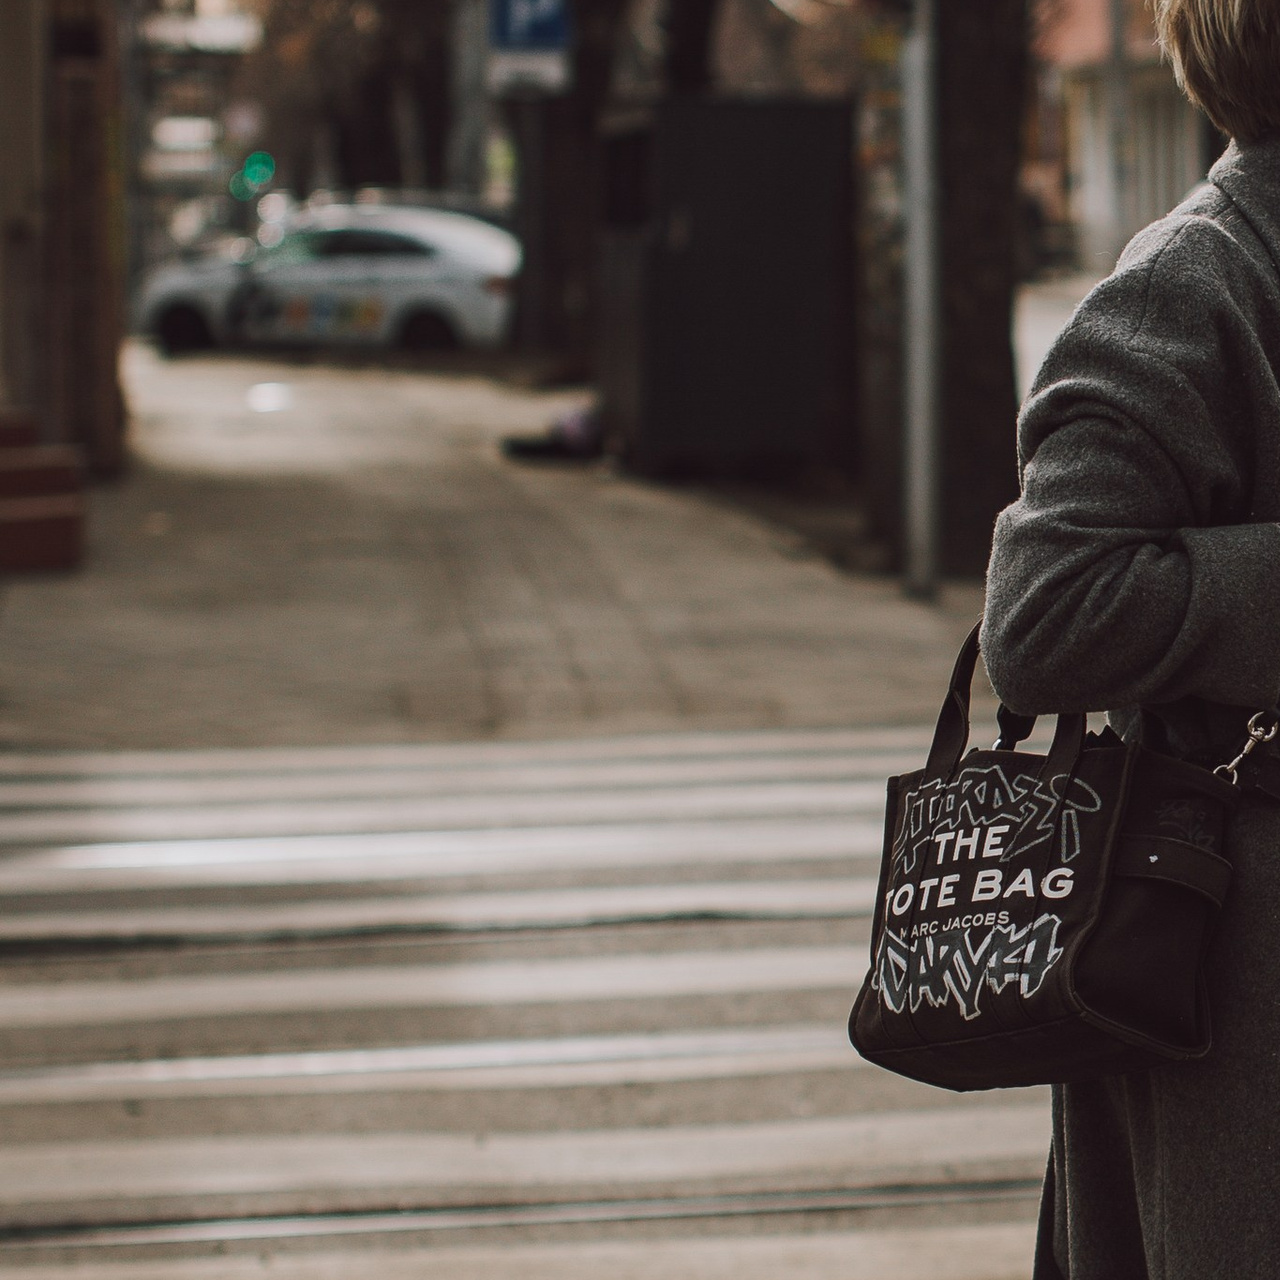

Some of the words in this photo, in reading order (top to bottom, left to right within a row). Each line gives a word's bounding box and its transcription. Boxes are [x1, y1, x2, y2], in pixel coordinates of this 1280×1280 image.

[935, 824, 1011, 865] THE
[886, 873, 961, 922] TOTE
[971, 867, 1075, 903] BAG
[900, 920, 939, 940] MARC
[942, 910, 1010, 932] JACOBS
